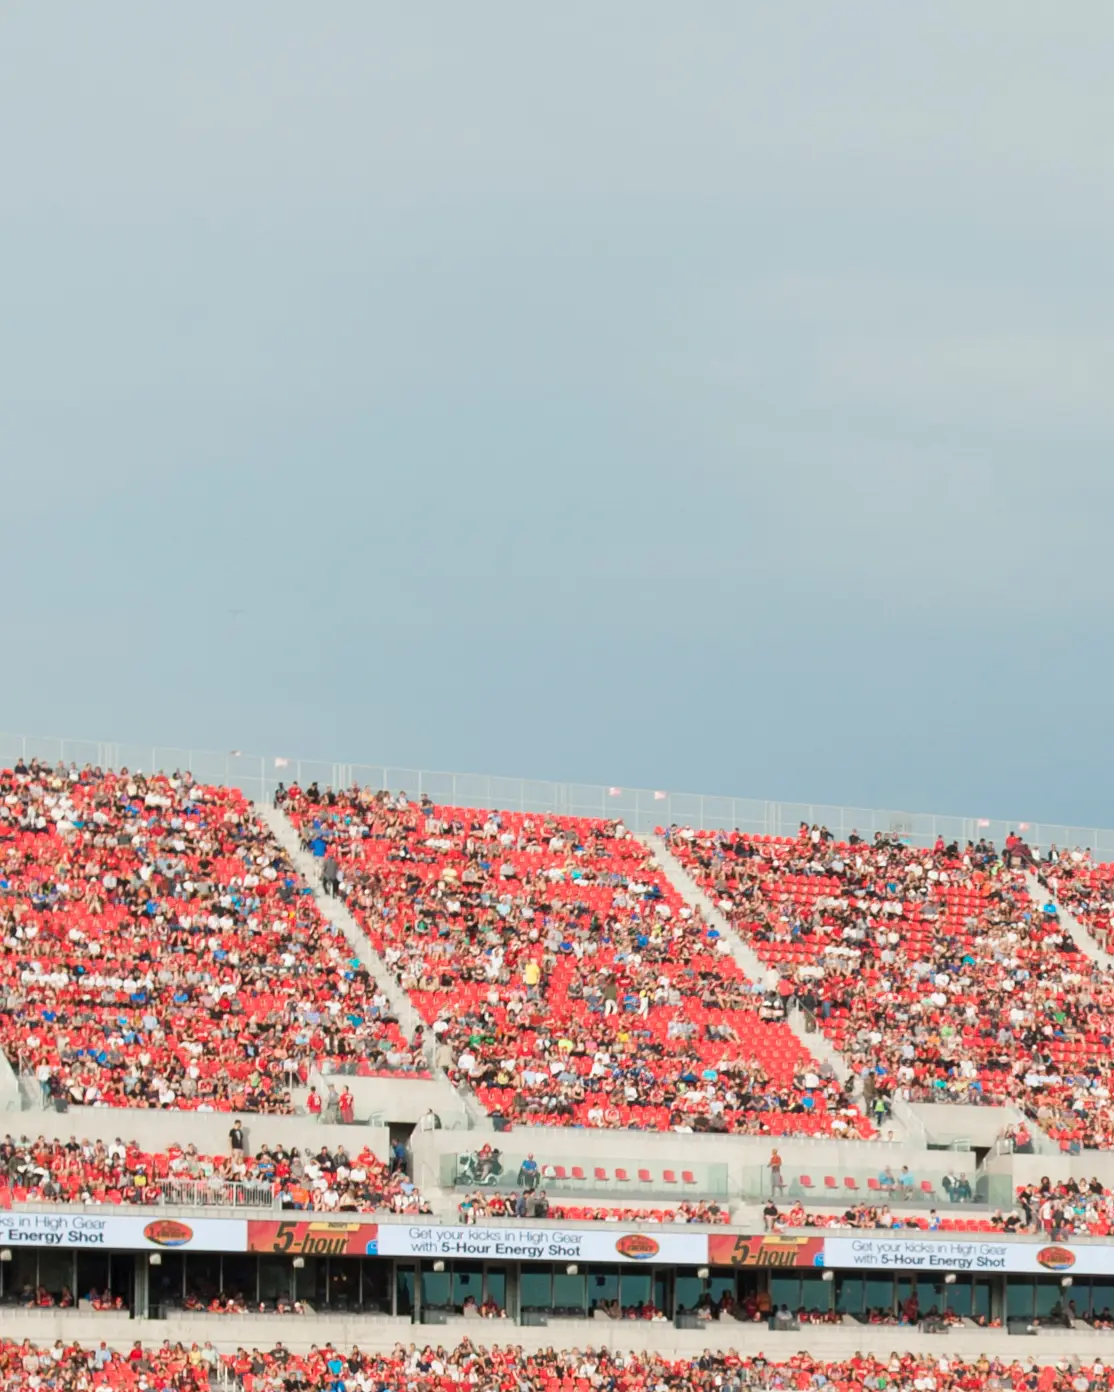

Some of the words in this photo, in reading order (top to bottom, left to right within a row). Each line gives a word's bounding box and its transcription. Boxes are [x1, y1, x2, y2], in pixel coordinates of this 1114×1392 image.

[19, 1216, 30, 1227] in
[35, 1216, 68, 1230] High
[72, 1217, 107, 1231] Gear
[9, 1229, 63, 1244] Energy
[68, 1230, 104, 1243] Shot
[273, 1221, 348, 1254] 5-hour
[408, 1228, 431, 1239] Get
[436, 1231, 463, 1244] your
[468, 1229, 501, 1241] kicks
[505, 1230, 516, 1241] in
[519, 1231, 548, 1245] High
[552, 1232, 582, 1244] Gear
[411, 1242, 437, 1253] with
[442, 1242, 490, 1254] 5-Hour
[495, 1243, 544, 1257] Energy
[548, 1244, 580, 1257] Shot
[731, 1235, 799, 1266] 5-hour
[852, 1240, 874, 1251] Get
[876, 1243, 901, 1255] your
[905, 1241, 936, 1253] kicks
[938, 1242, 948, 1254] in
[951, 1242, 977, 1256] High
[980, 1243, 1007, 1255] Gear
[854, 1254, 878, 1264] with
[881, 1254, 925, 1266] 5-Hour
[929, 1255, 973, 1268] Energy
[977, 1256, 1005, 1268] Shot
